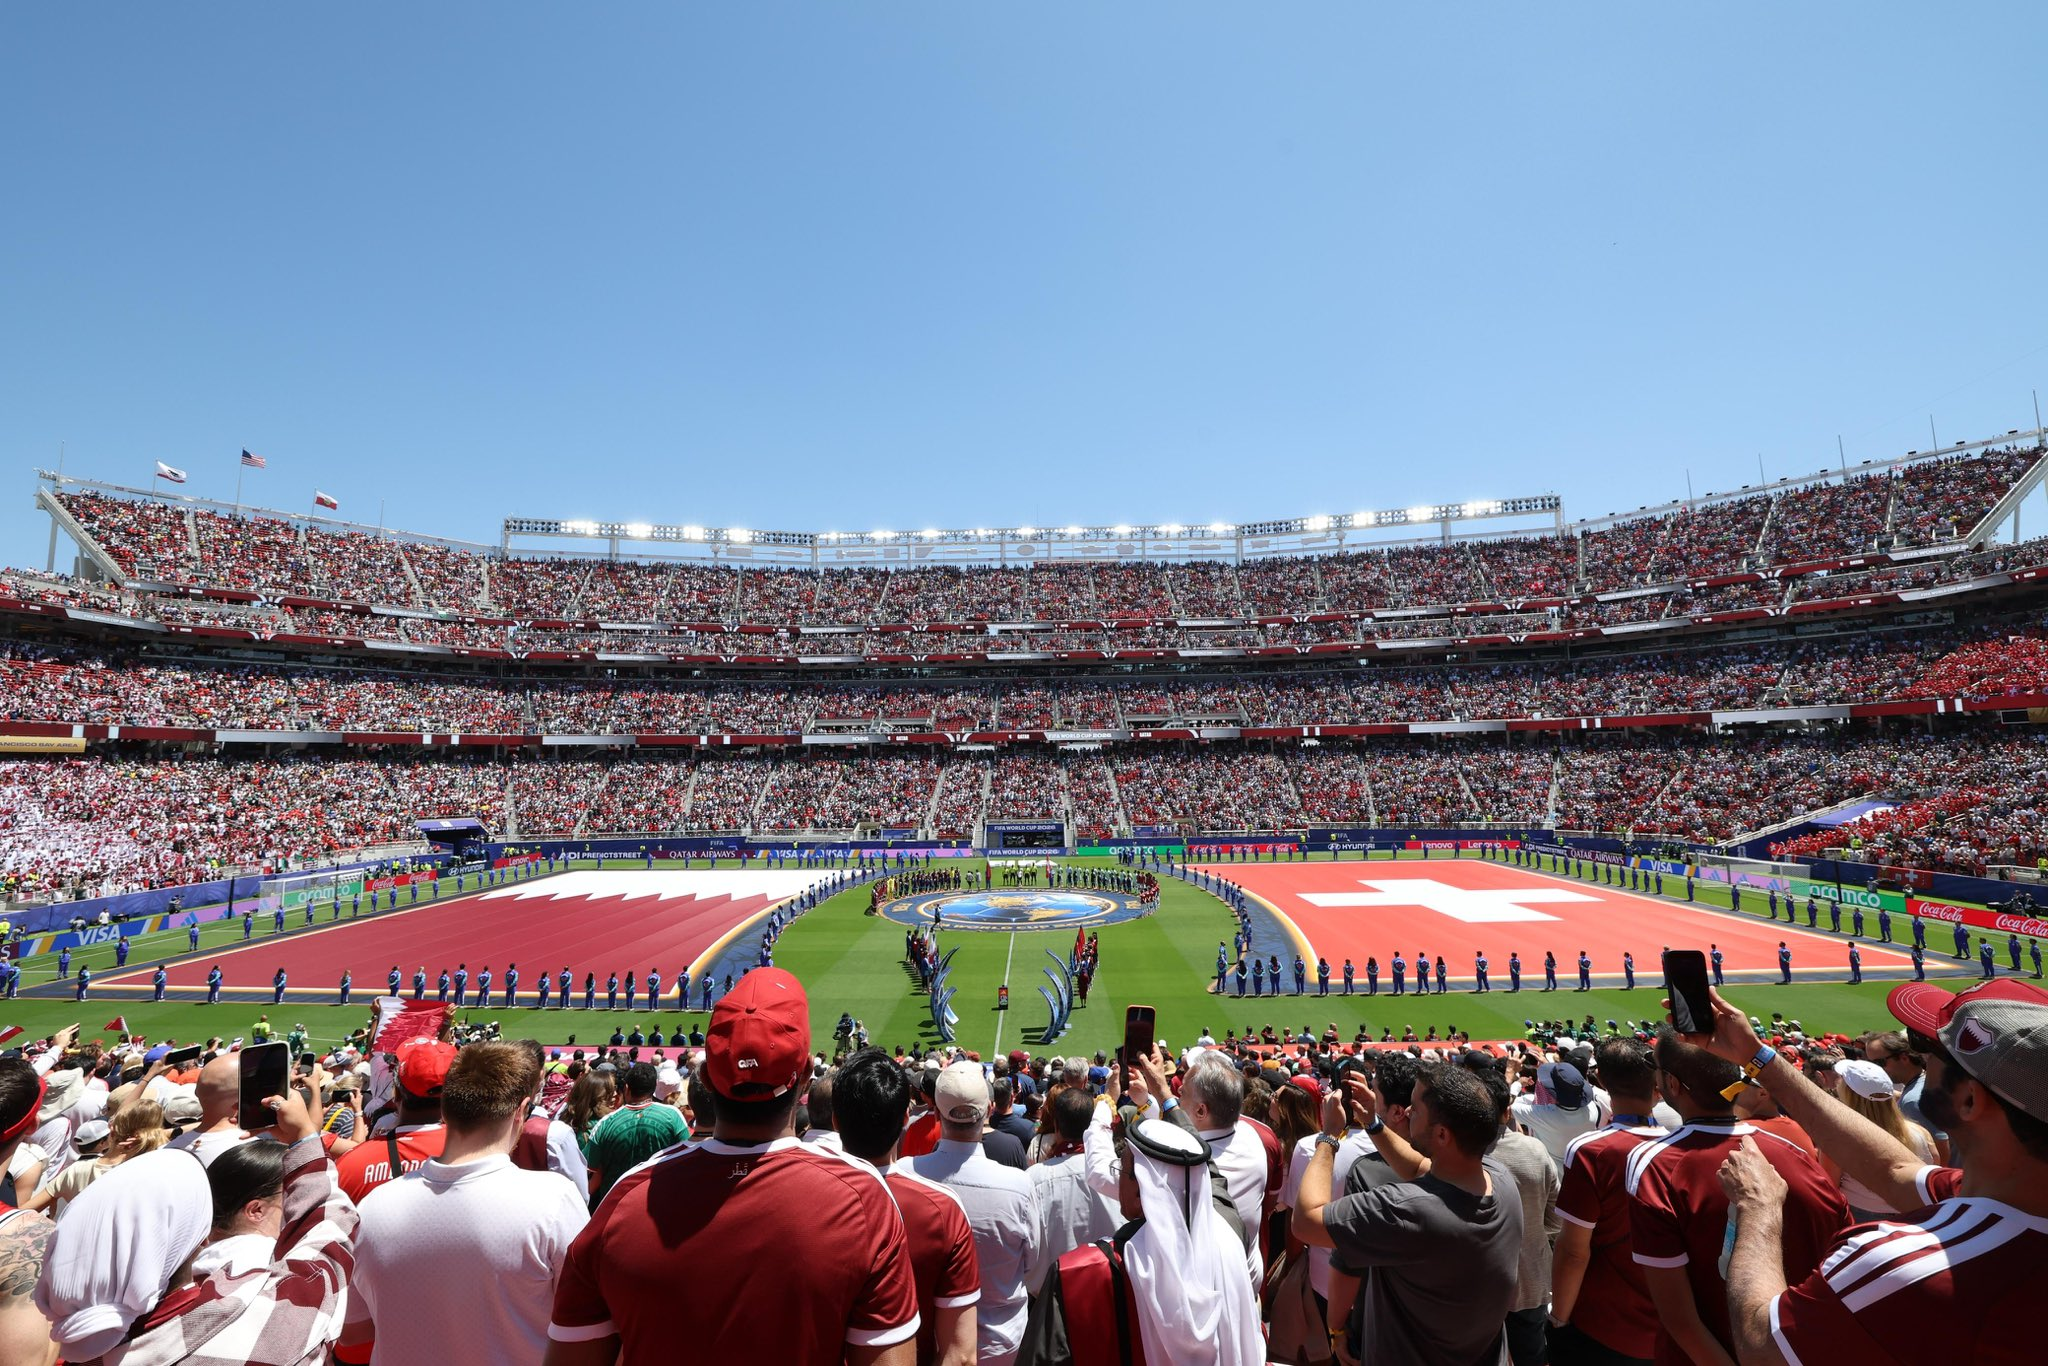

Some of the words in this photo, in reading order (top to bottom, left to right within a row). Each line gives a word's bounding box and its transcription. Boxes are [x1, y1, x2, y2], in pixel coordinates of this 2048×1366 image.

[1919, 548, 1945, 556] WORLD
[1421, 841, 1453, 850] Lenovo
[669, 850, 697, 858] QATAR
[700, 850, 736, 858] AIRWAYS
[1570, 848, 1593, 860] QATAR
[1595, 852, 1625, 865] AIRWAYS
[508, 856, 530, 867] Lenovo
[1650, 860, 1673, 874] VISA
[459, 863, 485, 874] HYUNDAI
[297, 883, 351, 903] aramco
[1809, 885, 1881, 908] aramco
[1918, 901, 1964, 922] Coca-Cola
[1995, 914, 2048, 937] Coca-Cola
[75, 924, 121, 946] VISA
[738, 1058, 759, 1069] QFA
